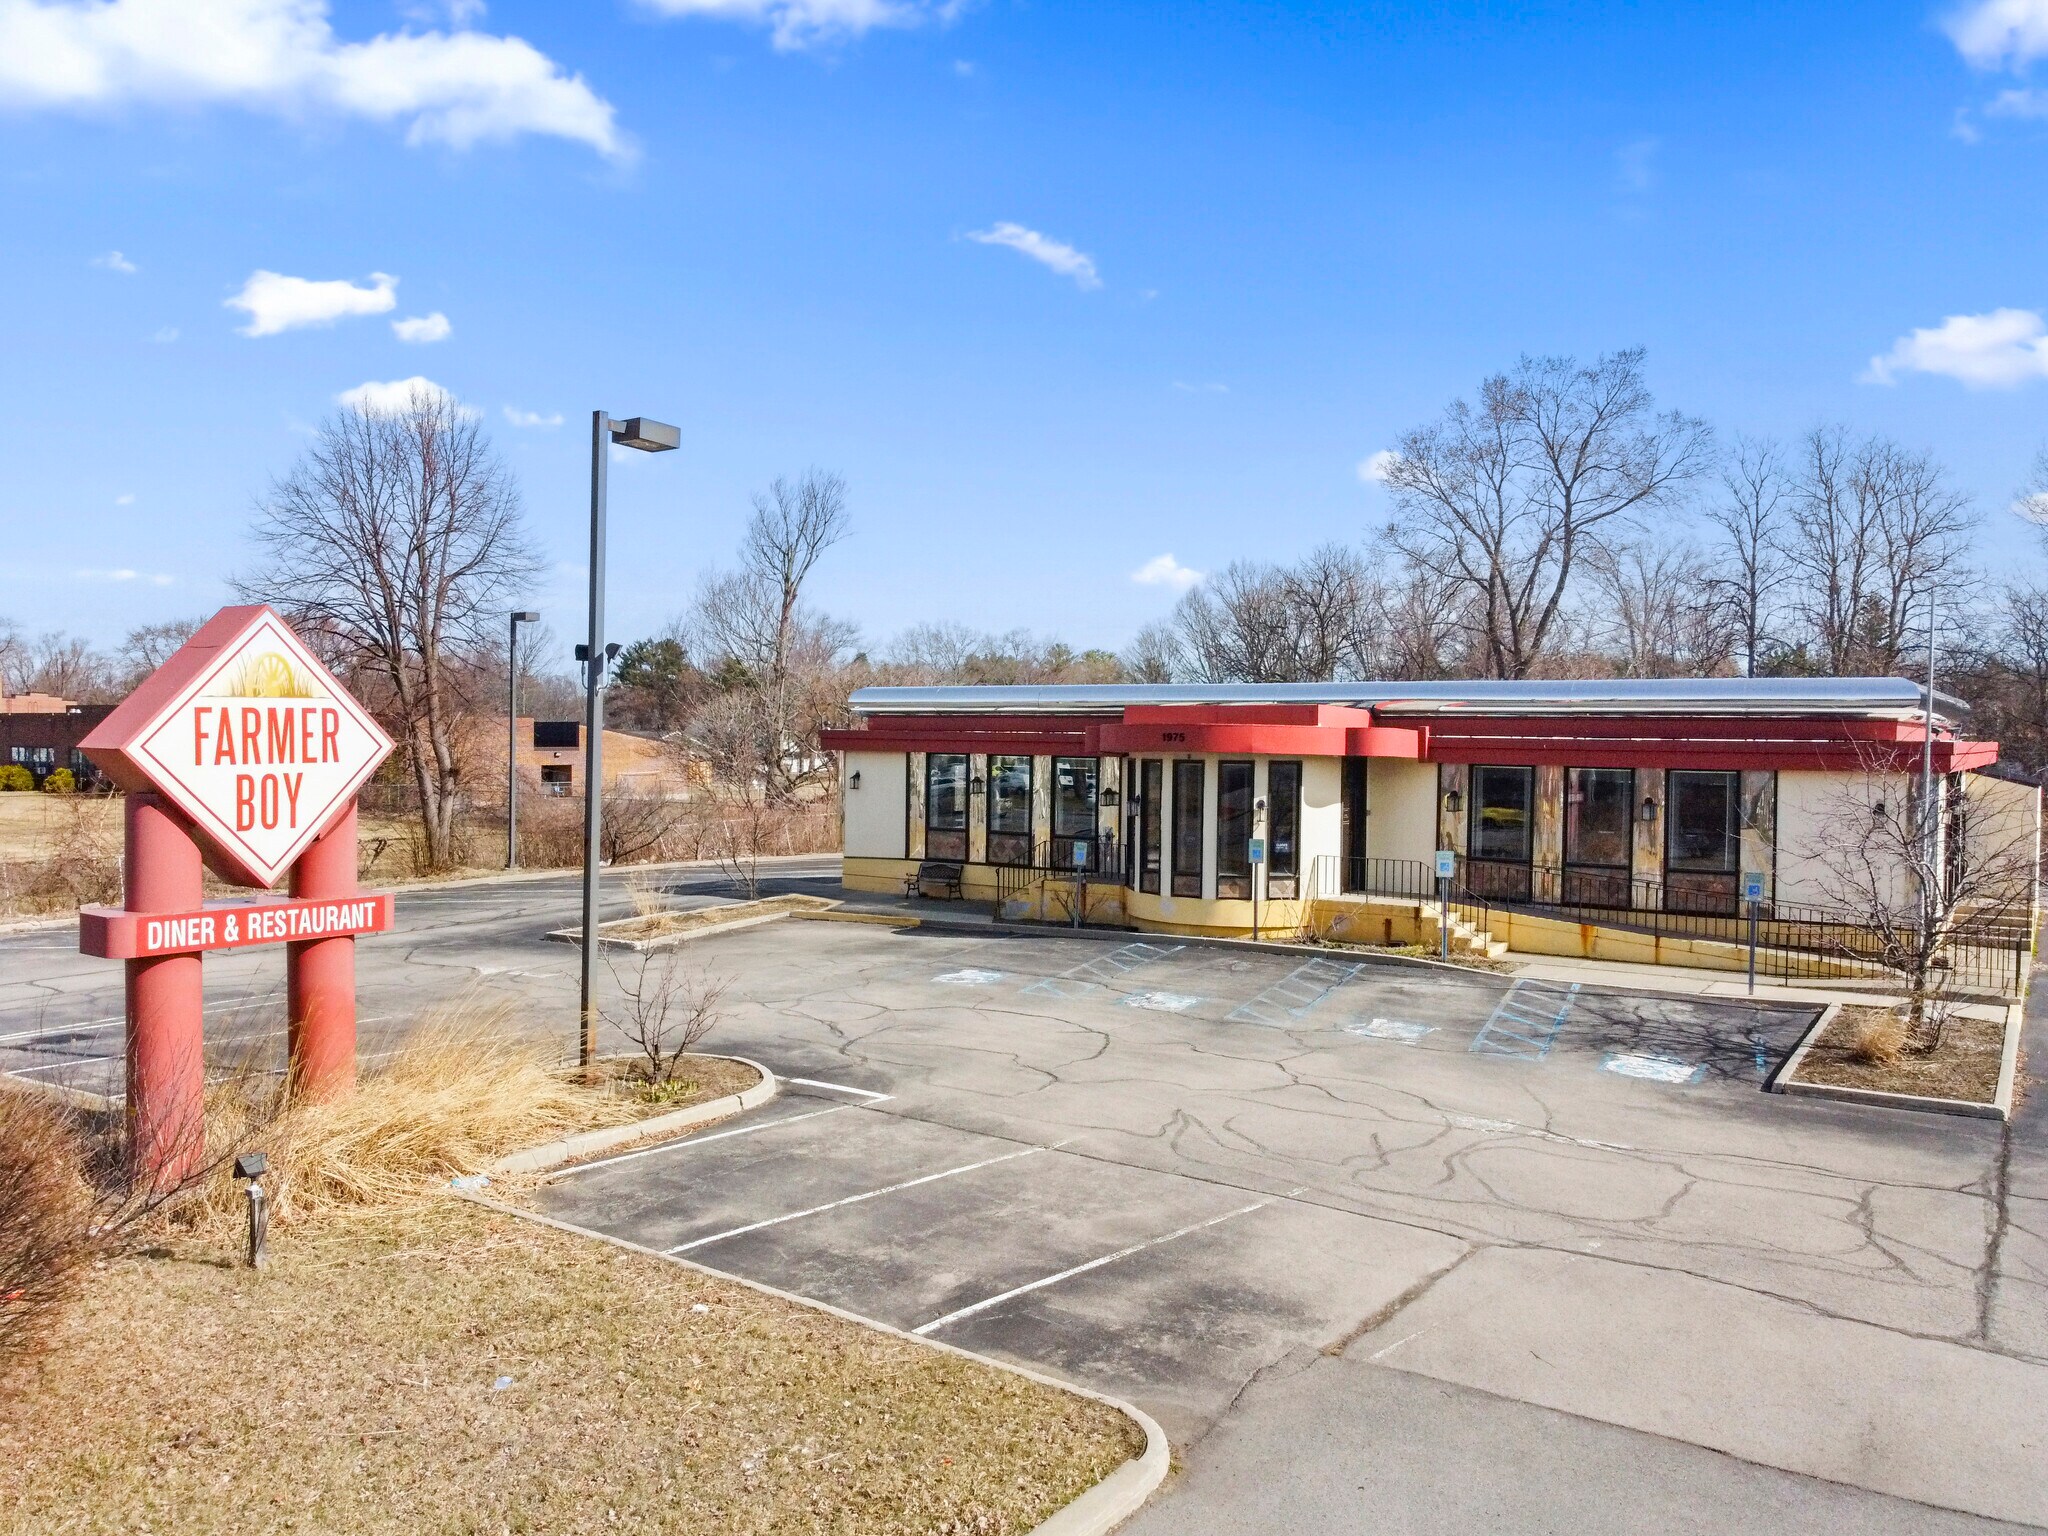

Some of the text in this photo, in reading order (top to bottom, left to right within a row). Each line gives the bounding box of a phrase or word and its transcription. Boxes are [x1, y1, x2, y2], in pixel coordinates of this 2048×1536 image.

[194, 706, 340, 766] FARMER
[1162, 732, 1185, 742] 1975
[236, 772, 304, 832] BOY
[147, 902, 376, 950] DINER & RESTAURANT
